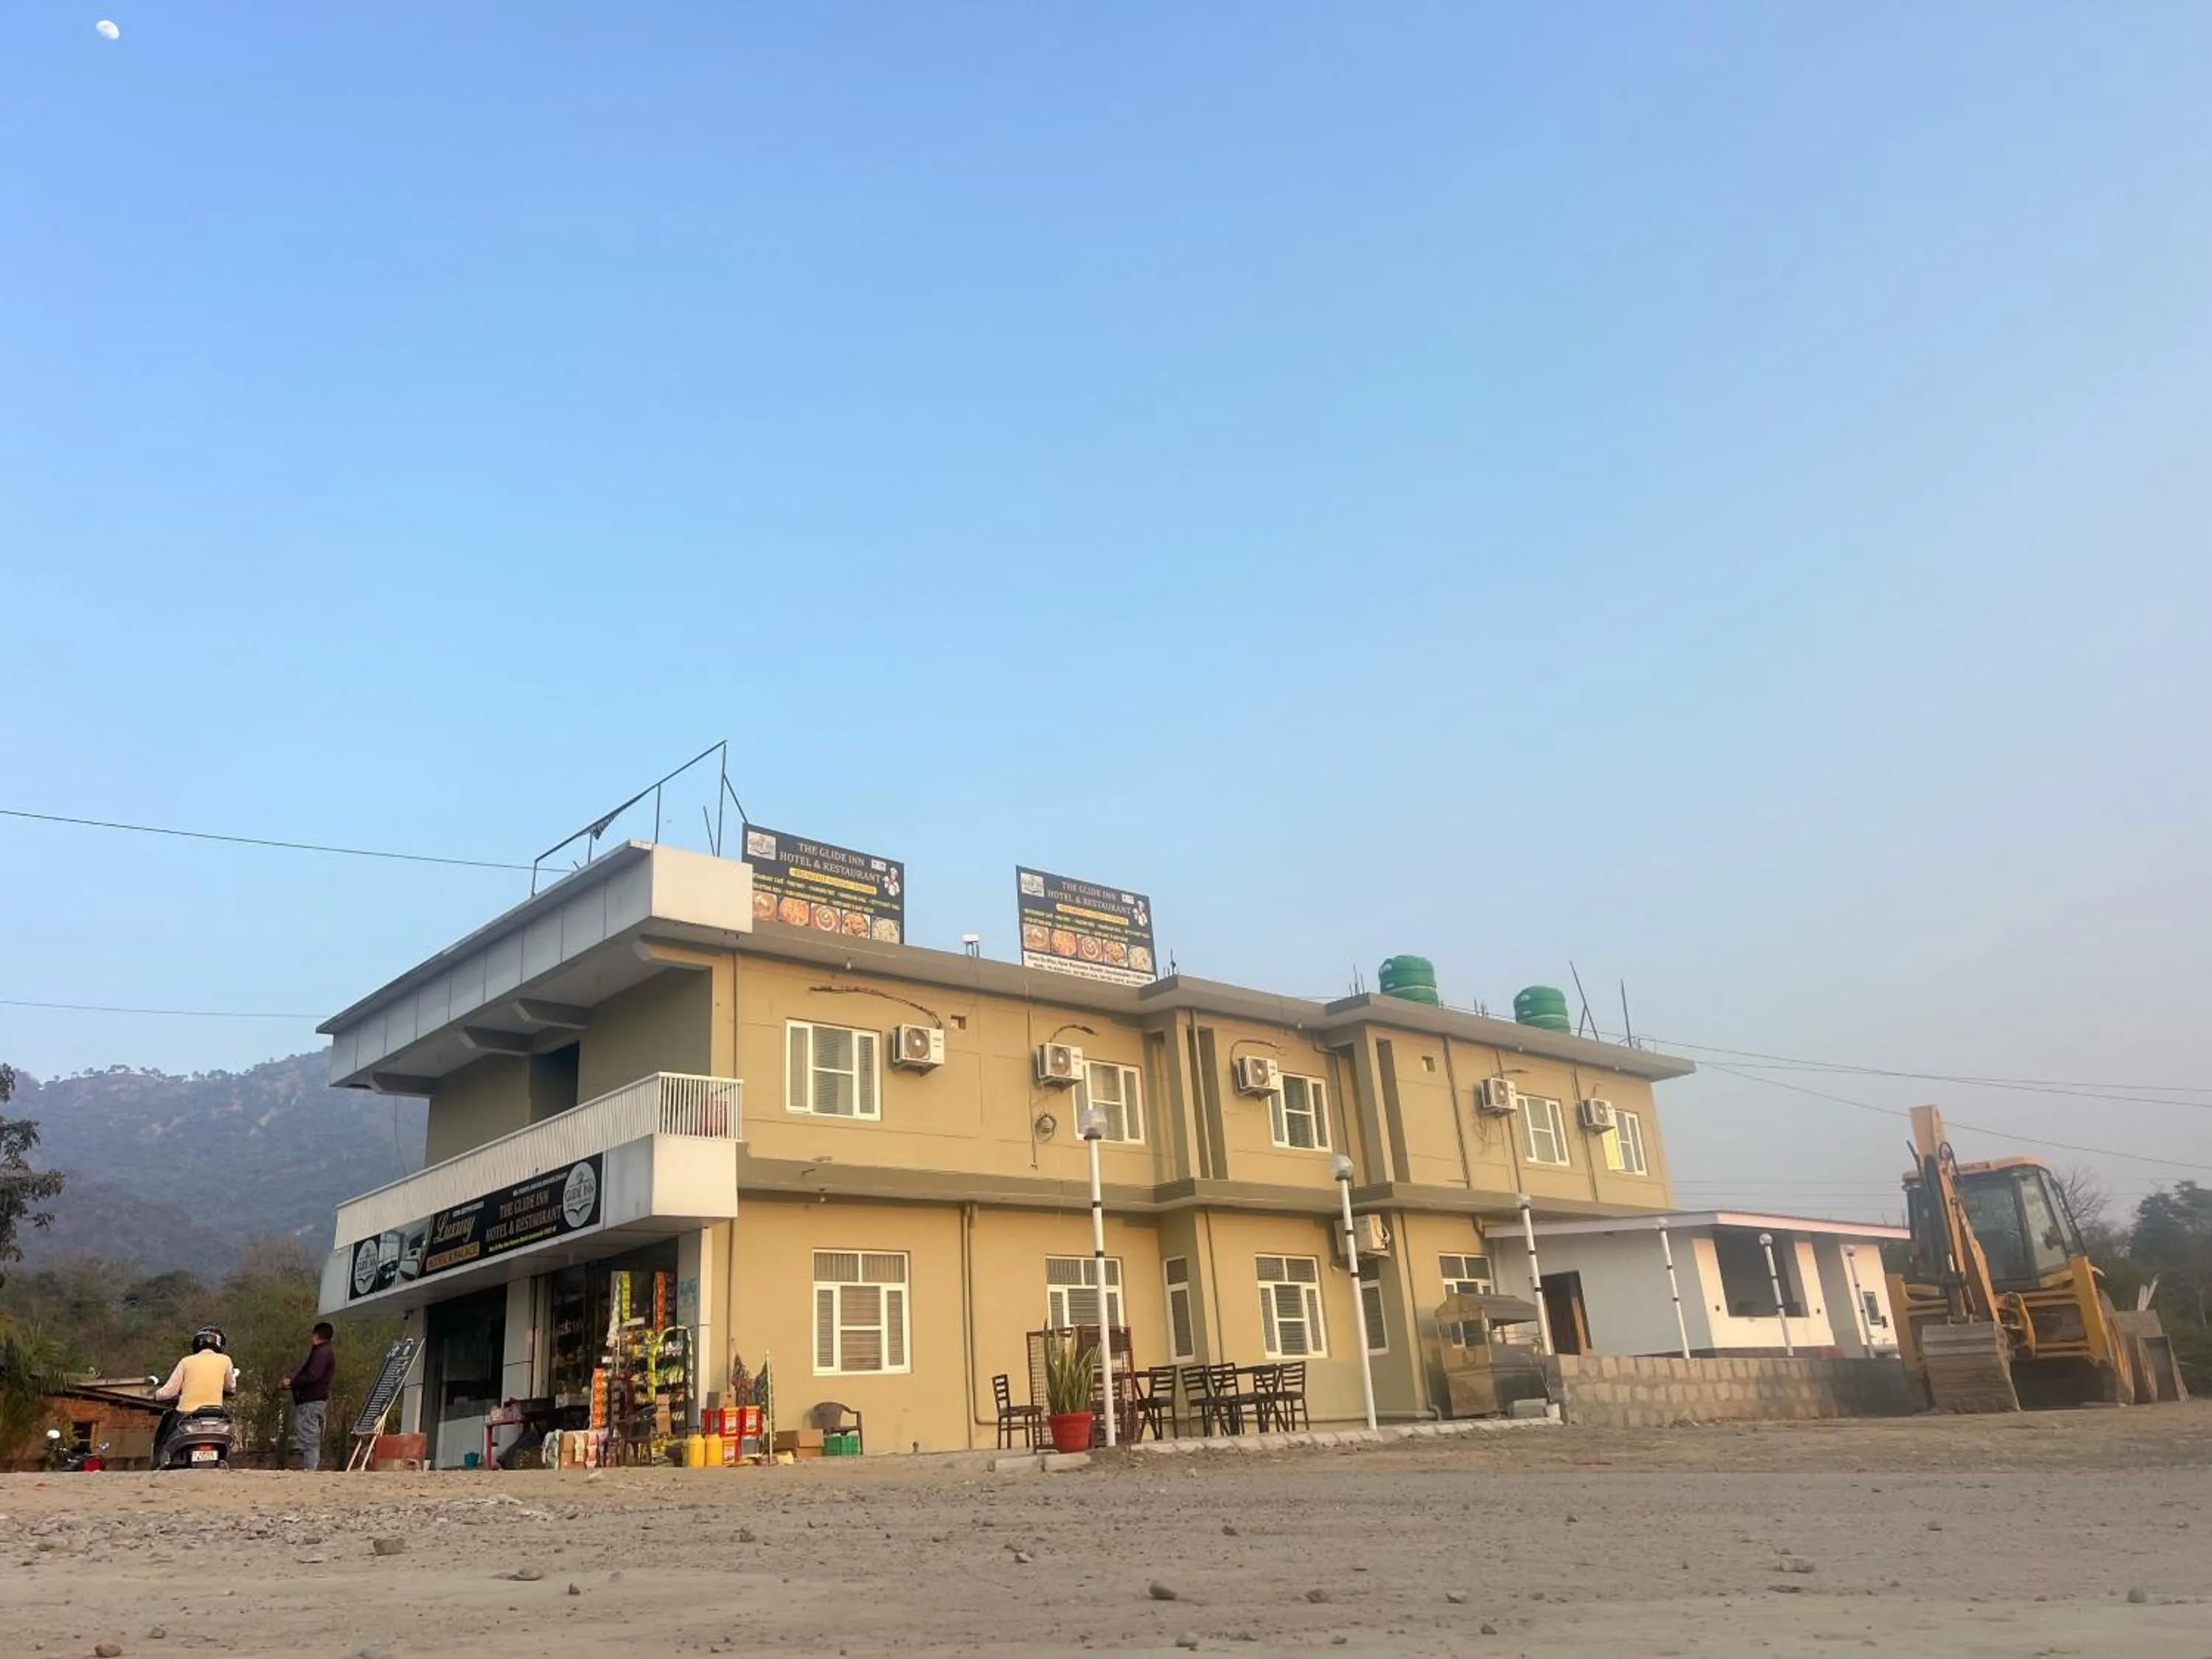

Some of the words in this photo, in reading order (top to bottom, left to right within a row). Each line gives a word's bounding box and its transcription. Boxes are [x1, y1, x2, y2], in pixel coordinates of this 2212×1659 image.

[779, 851, 812, 868] HOTEL
[813, 859, 821, 869] &
[823, 862, 881, 883] RESTAURANT
[798, 843, 818, 856] THE
[819, 848, 847, 863] GLIDE
[849, 855, 865, 867] INN
[1062, 881, 1077, 891] THE
[1048, 890, 1072, 902] HOTEL
[1082, 896, 1132, 914] RESTAURANT
[499, 1203, 515, 1220] THE
[515, 1194, 535, 1215] GLIDE
[433, 1211, 476, 1245] Luxury
[485, 1222, 508, 1242] HOTEL
[509, 1221, 515, 1234] &
[516, 1204, 563, 1234] RESTAURANT
